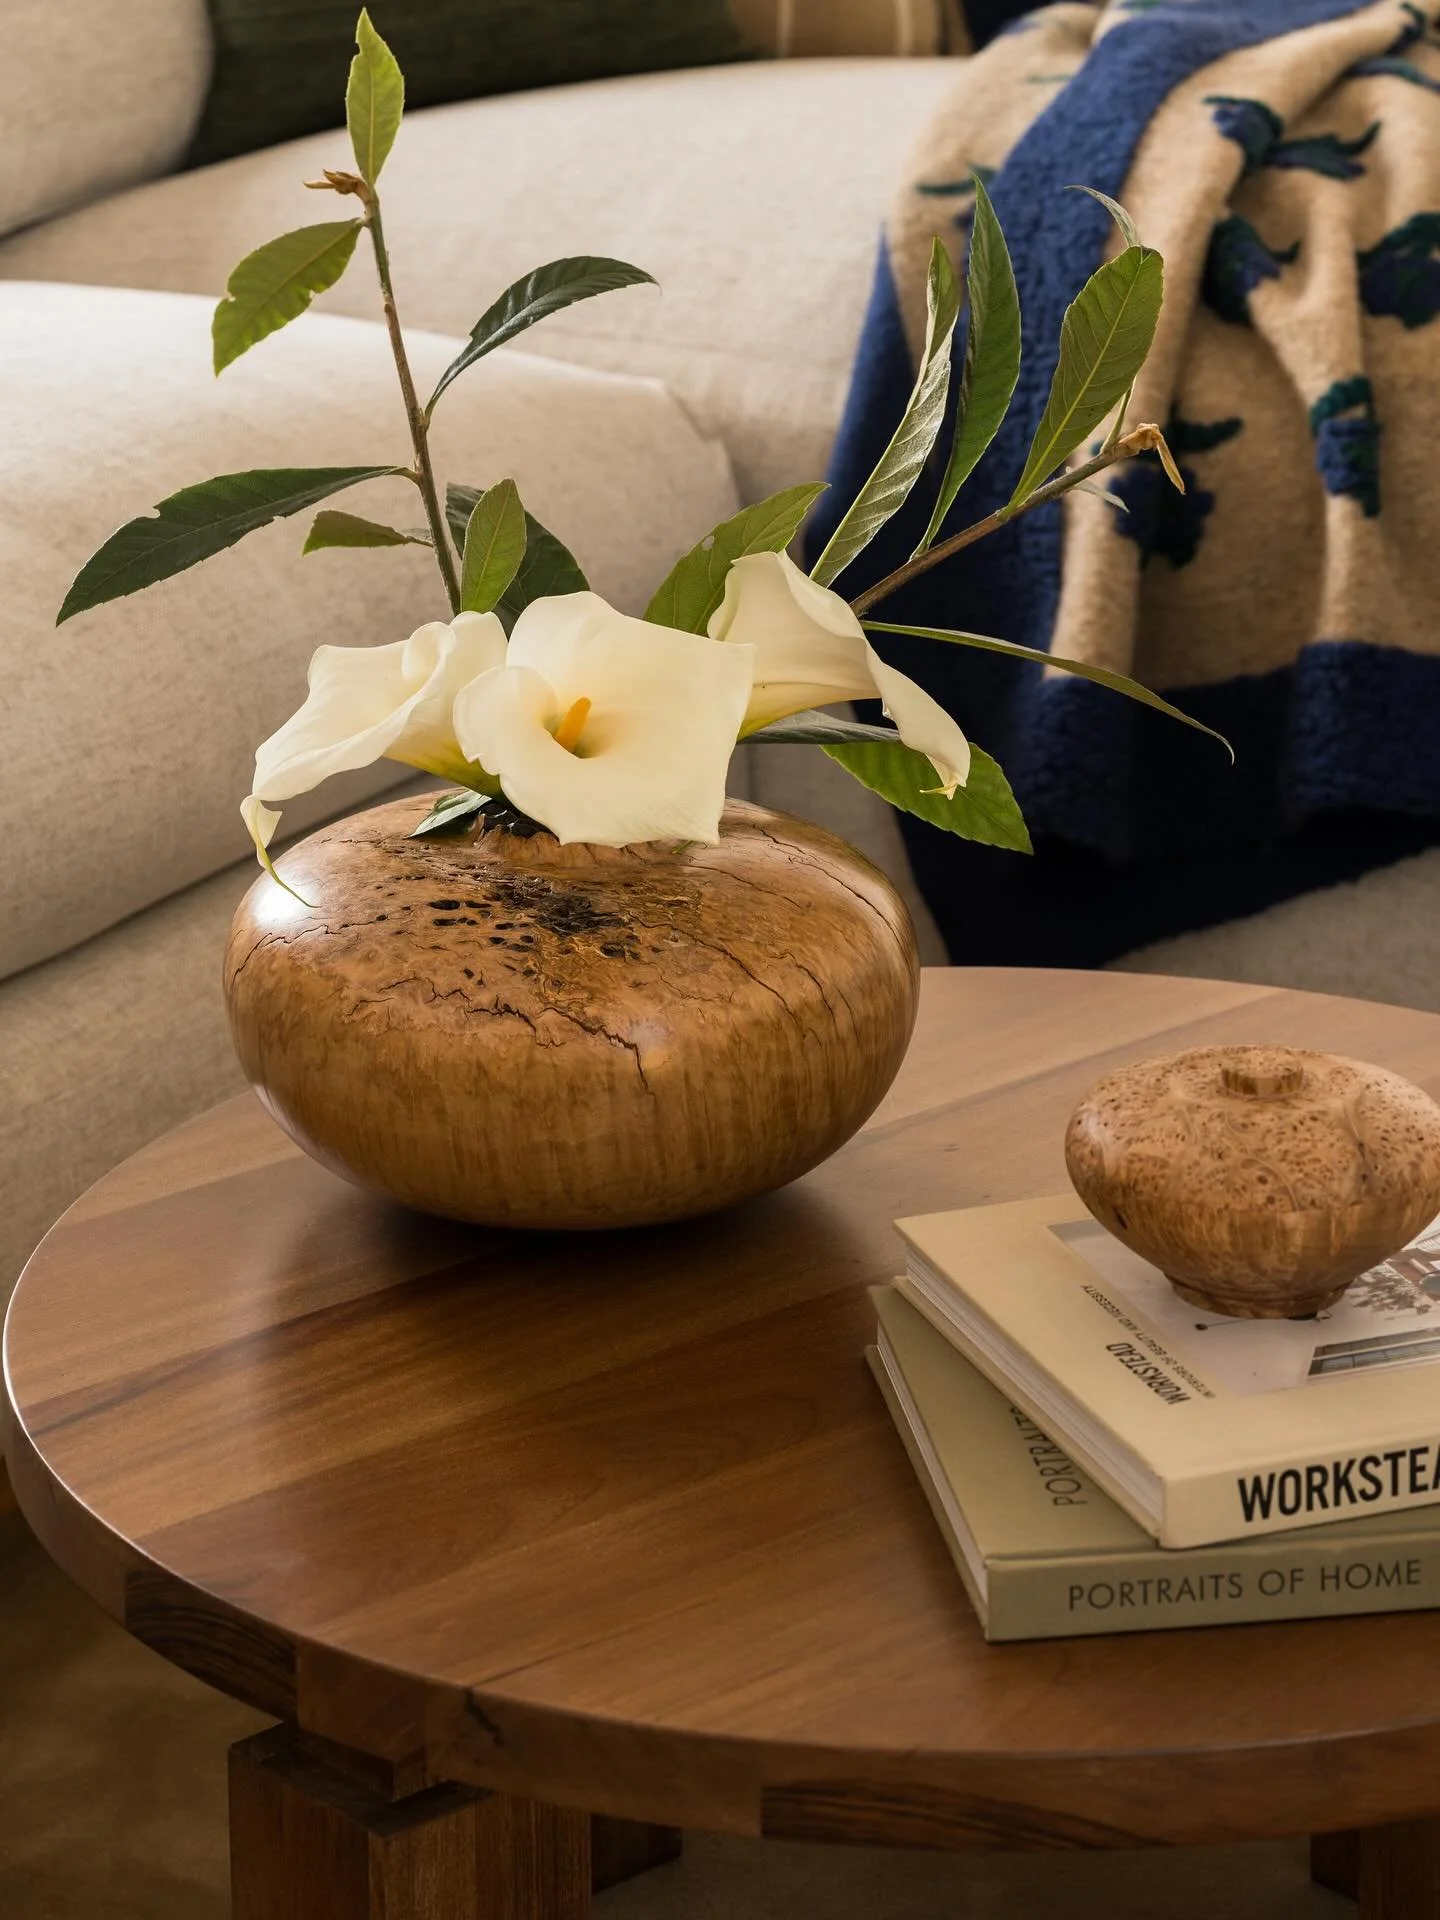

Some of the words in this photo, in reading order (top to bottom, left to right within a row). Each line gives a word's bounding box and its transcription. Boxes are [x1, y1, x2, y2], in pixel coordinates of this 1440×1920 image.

[1080, 1285, 1126, 1318] NECESSITY
[1117, 1317, 1140, 1333] AND
[1134, 1332, 1168, 1356] BEAUTY
[1105, 1342, 1192, 1405] WORKSTEAD
[1172, 1365, 1217, 1399] INTERIORS
[1069, 1573, 1243, 1611] PORTRAITS
[1259, 1569, 1305, 1597] OF
[1320, 1559, 1421, 1592] HOME
